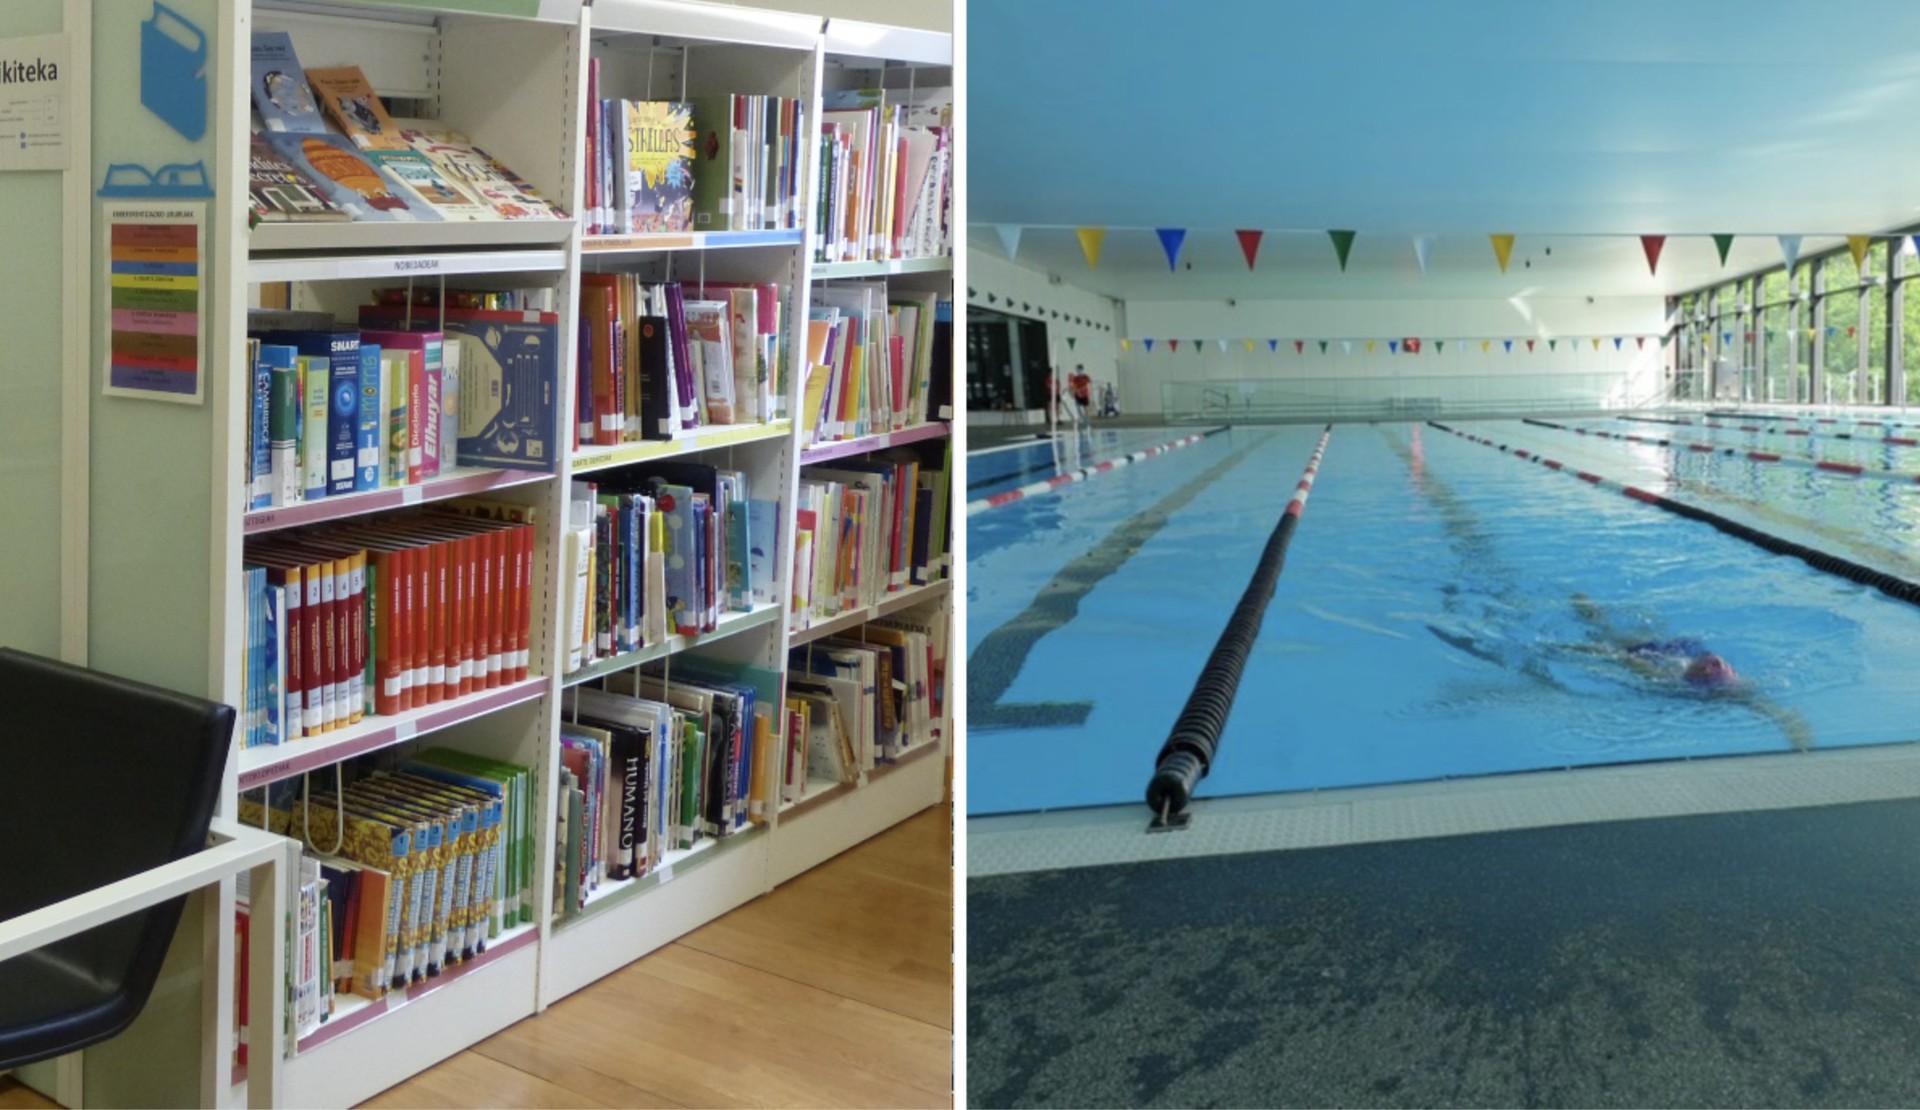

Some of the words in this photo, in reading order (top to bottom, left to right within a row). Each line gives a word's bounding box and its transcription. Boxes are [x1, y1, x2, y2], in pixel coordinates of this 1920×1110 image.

[330, 340, 360, 352] SMART
[411, 383, 420, 446] Diccionario
[424, 374, 440, 459] Elhuyar
[621, 757, 639, 849] HUMANO
